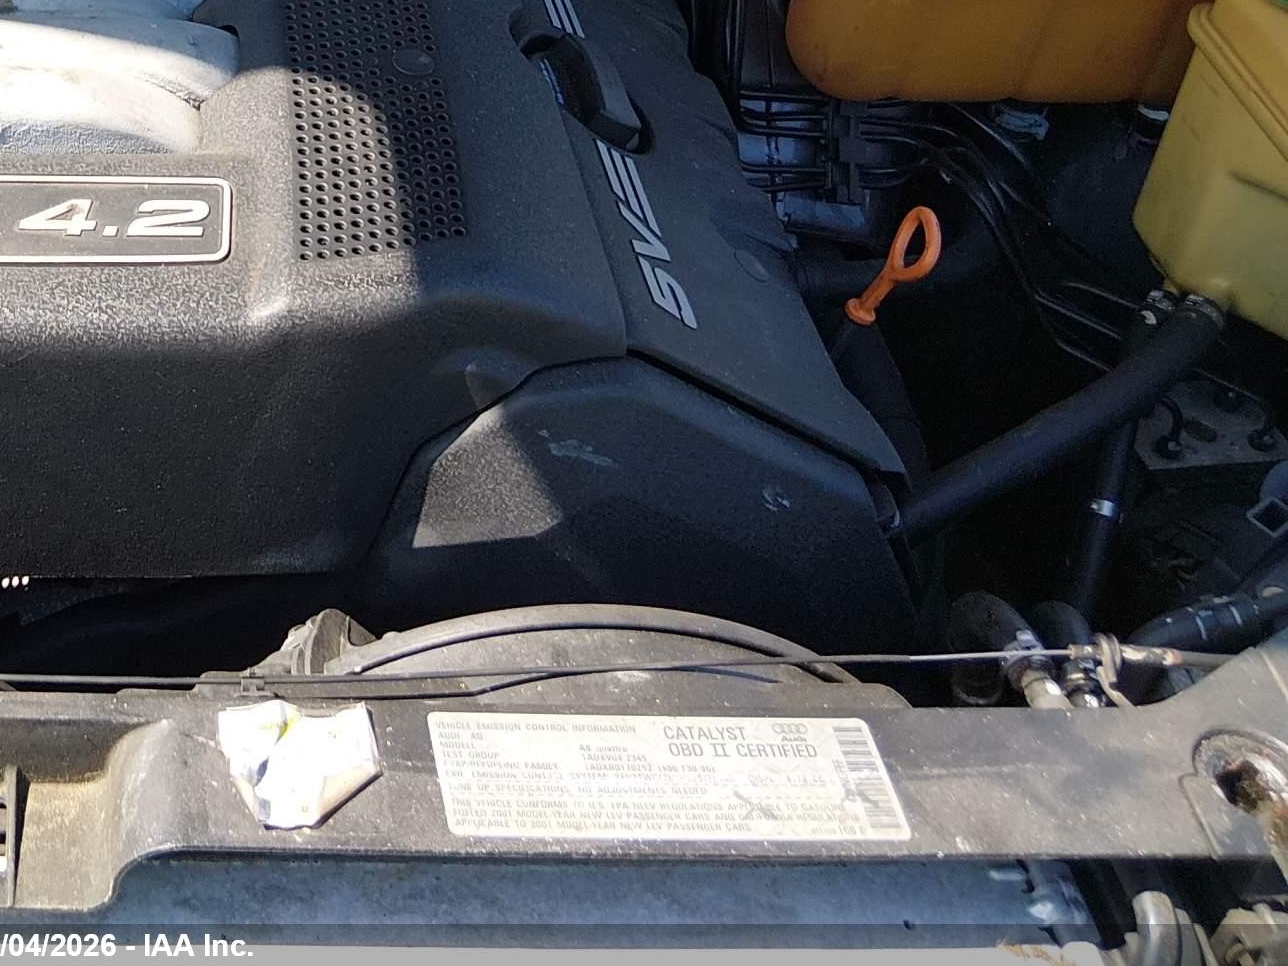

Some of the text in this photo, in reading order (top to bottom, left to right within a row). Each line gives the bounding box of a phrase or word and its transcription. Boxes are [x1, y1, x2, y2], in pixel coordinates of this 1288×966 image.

[18, 197, 211, 237] 4.2
[663, 724, 746, 741] CATALYST
[668, 742, 818, 758] OBD II CERTIFIED
